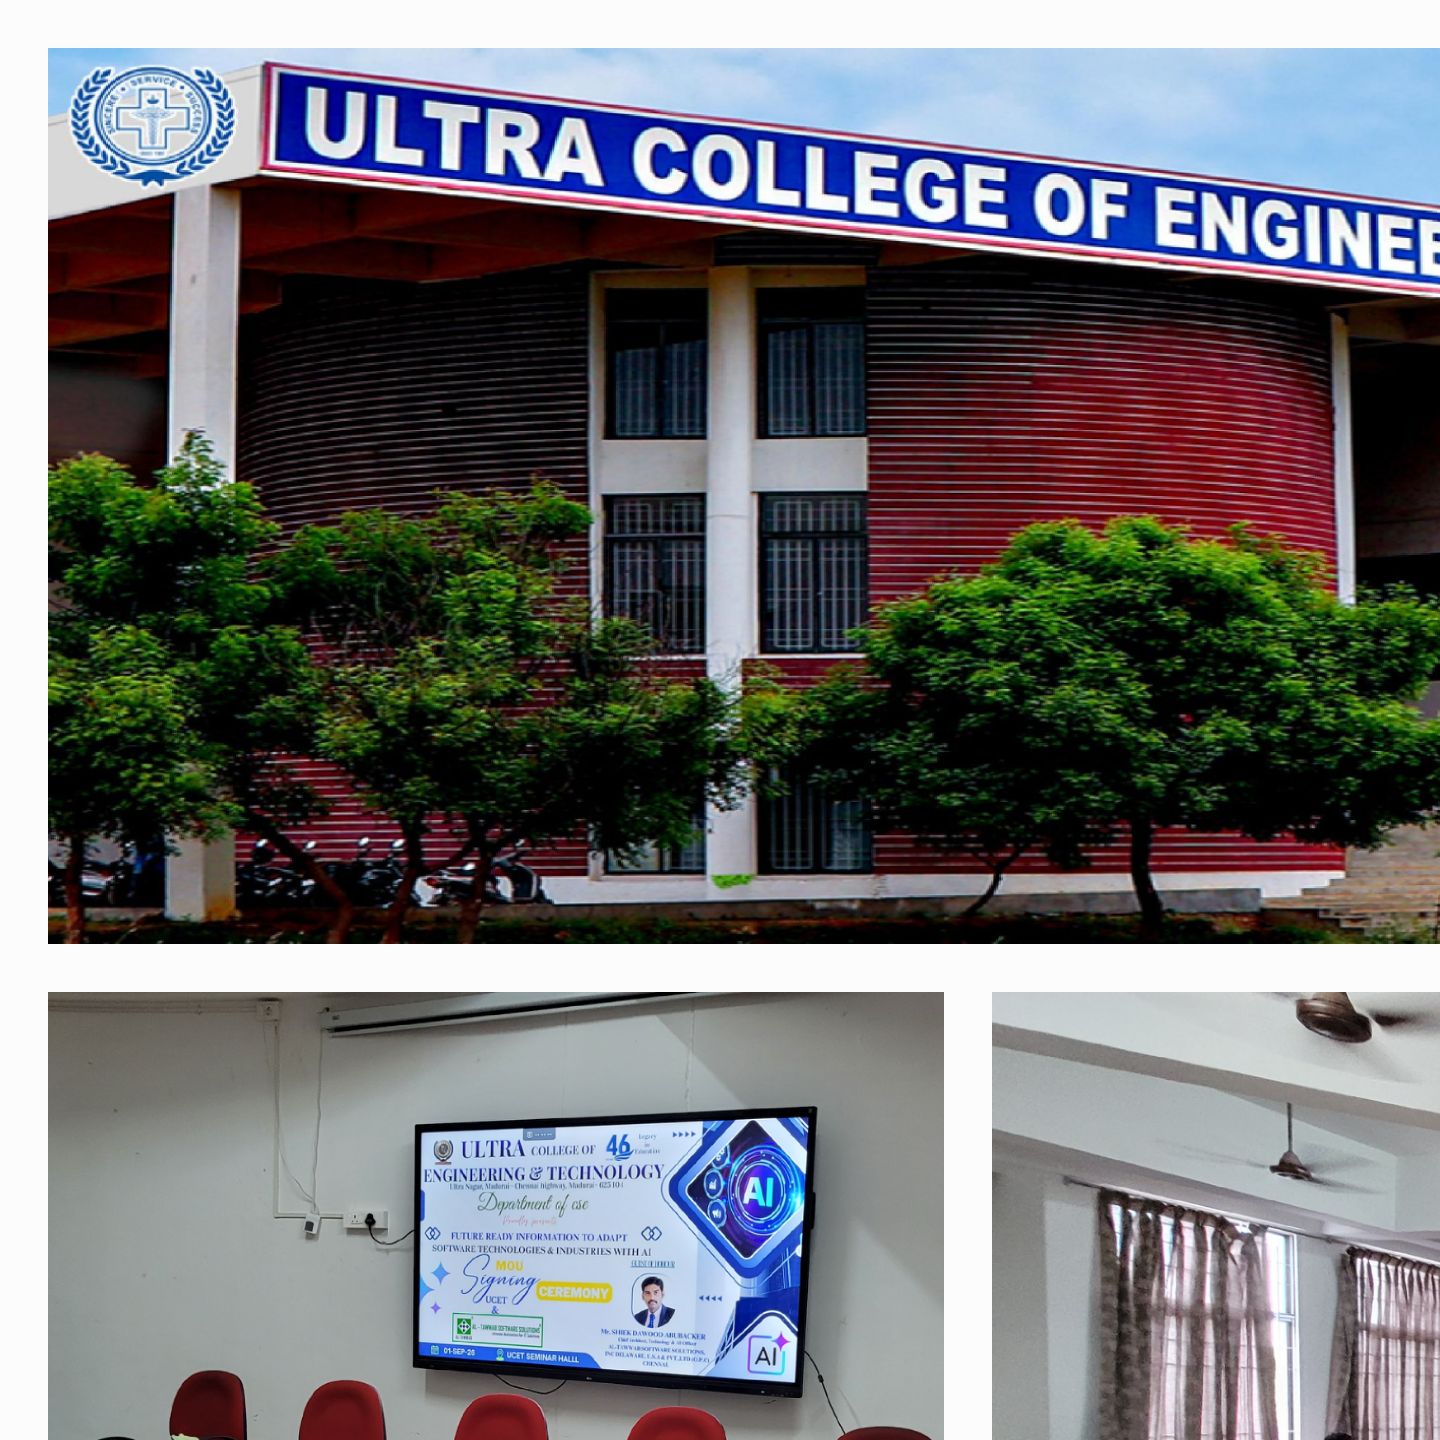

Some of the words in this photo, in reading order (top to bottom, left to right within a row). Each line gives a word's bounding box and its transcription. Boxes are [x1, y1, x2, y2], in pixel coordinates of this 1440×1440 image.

[303, 86, 606, 188] ULTRA
[631, 127, 1007, 230] COLLEGE
[1031, 171, 1130, 243] OF
[462, 1139, 526, 1159] ULTRA
[531, 1145, 580, 1156] COLLEGE
[582, 1145, 596, 1155] OF
[606, 1134, 631, 1156] 46
[424, 1166, 526, 1183] ENGINEERING
[529, 1166, 544, 1181] &
[547, 1164, 665, 1180] TECHNOLOGY
[743, 1177, 774, 1207] AI
[477, 1192, 553, 1216] Department
[555, 1194, 570, 1218] of
[451, 1232, 484, 1241] FUTURE
[486, 1232, 513, 1241] READY
[516, 1233, 580, 1242] INFORMATION
[582, 1233, 595, 1241] TO
[597, 1234, 628, 1242] ADAPT
[432, 1244, 478, 1253] SOFTWARE
[479, 1245, 546, 1254] TECHNOLOGIES
[556, 1247, 612, 1256] INDUSTRIES
[614, 1248, 639, 1256] WITH
[496, 1260, 523, 1271] MOU
[460, 1254, 541, 1305] Signing
[486, 1296, 508, 1304] UCET
[540, 1286, 608, 1299] CEREMONY
[492, 1306, 499, 1314] &
[507, 1352, 524, 1360] UCET
[755, 1347, 777, 1366] AI
